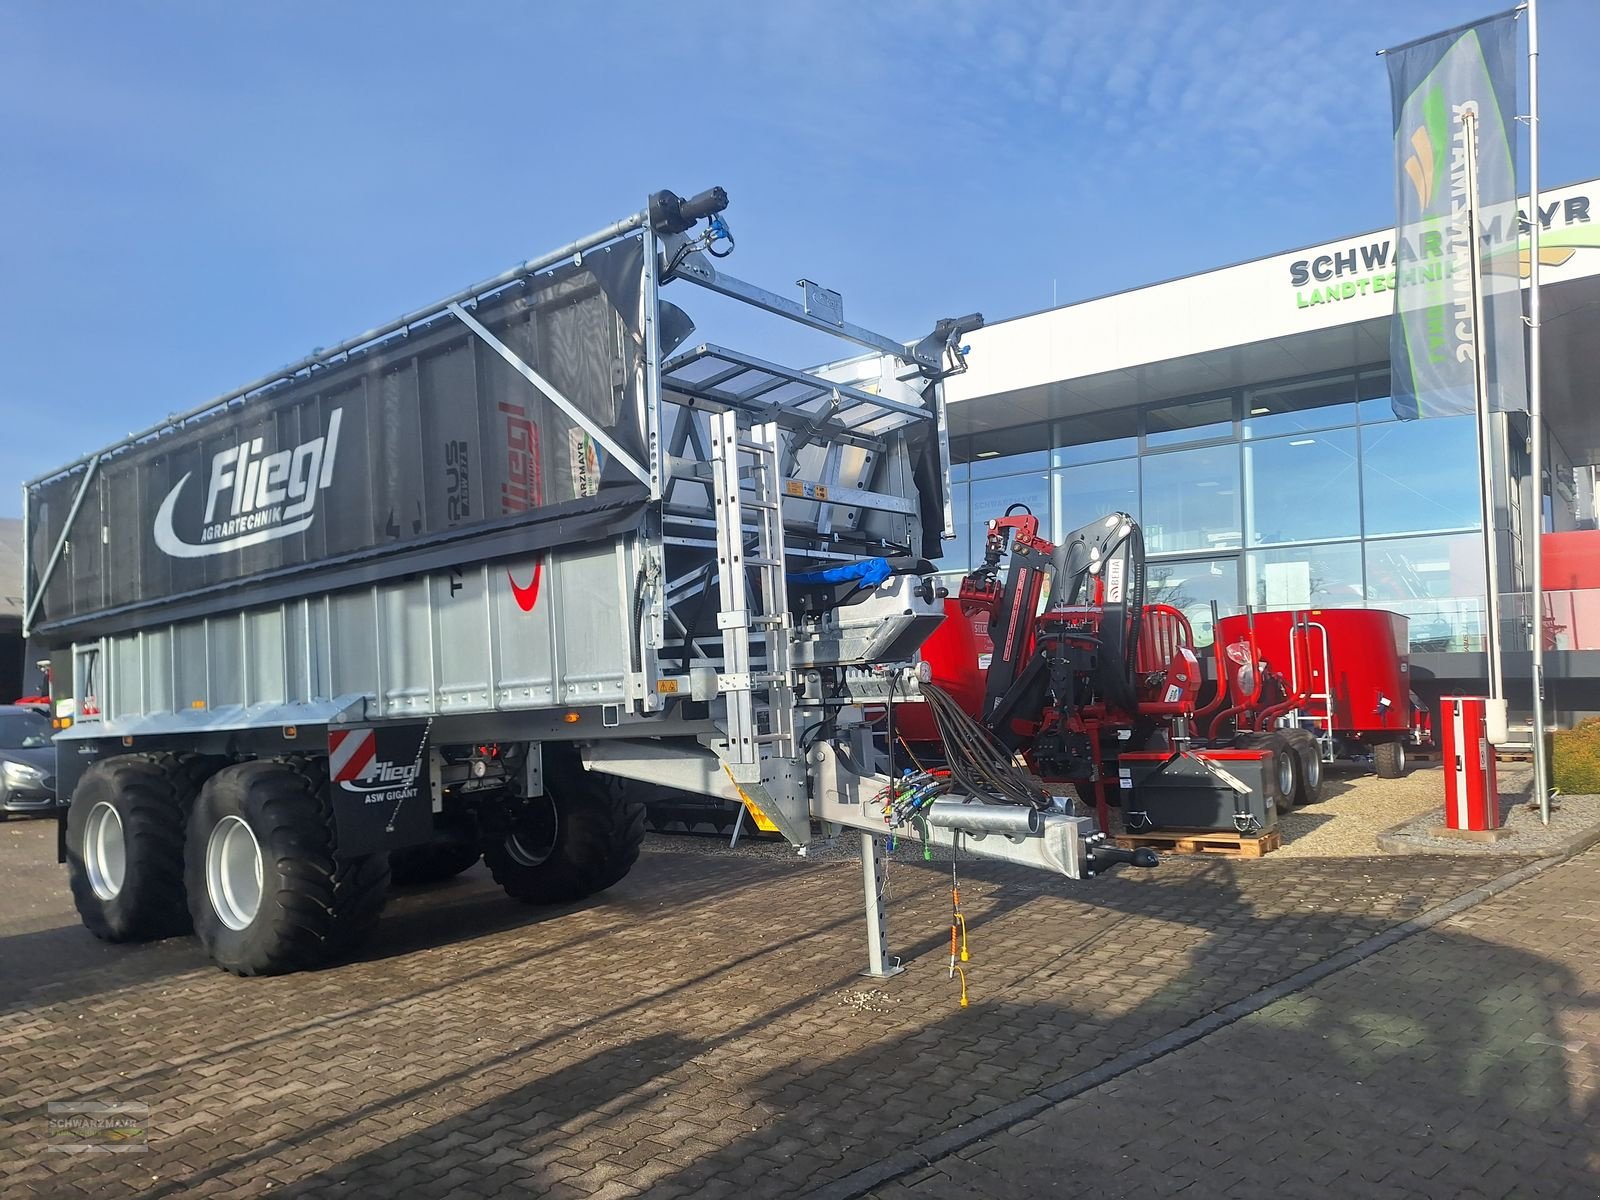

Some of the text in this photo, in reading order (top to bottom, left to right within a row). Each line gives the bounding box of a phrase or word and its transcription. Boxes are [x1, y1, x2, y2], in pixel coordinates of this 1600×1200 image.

[204, 407, 343, 524] Fliegl
[498, 402, 532, 515] liegl
[201, 507, 282, 543] AGRARTECHNIK
[364, 788, 418, 804] ASW GIGANT
